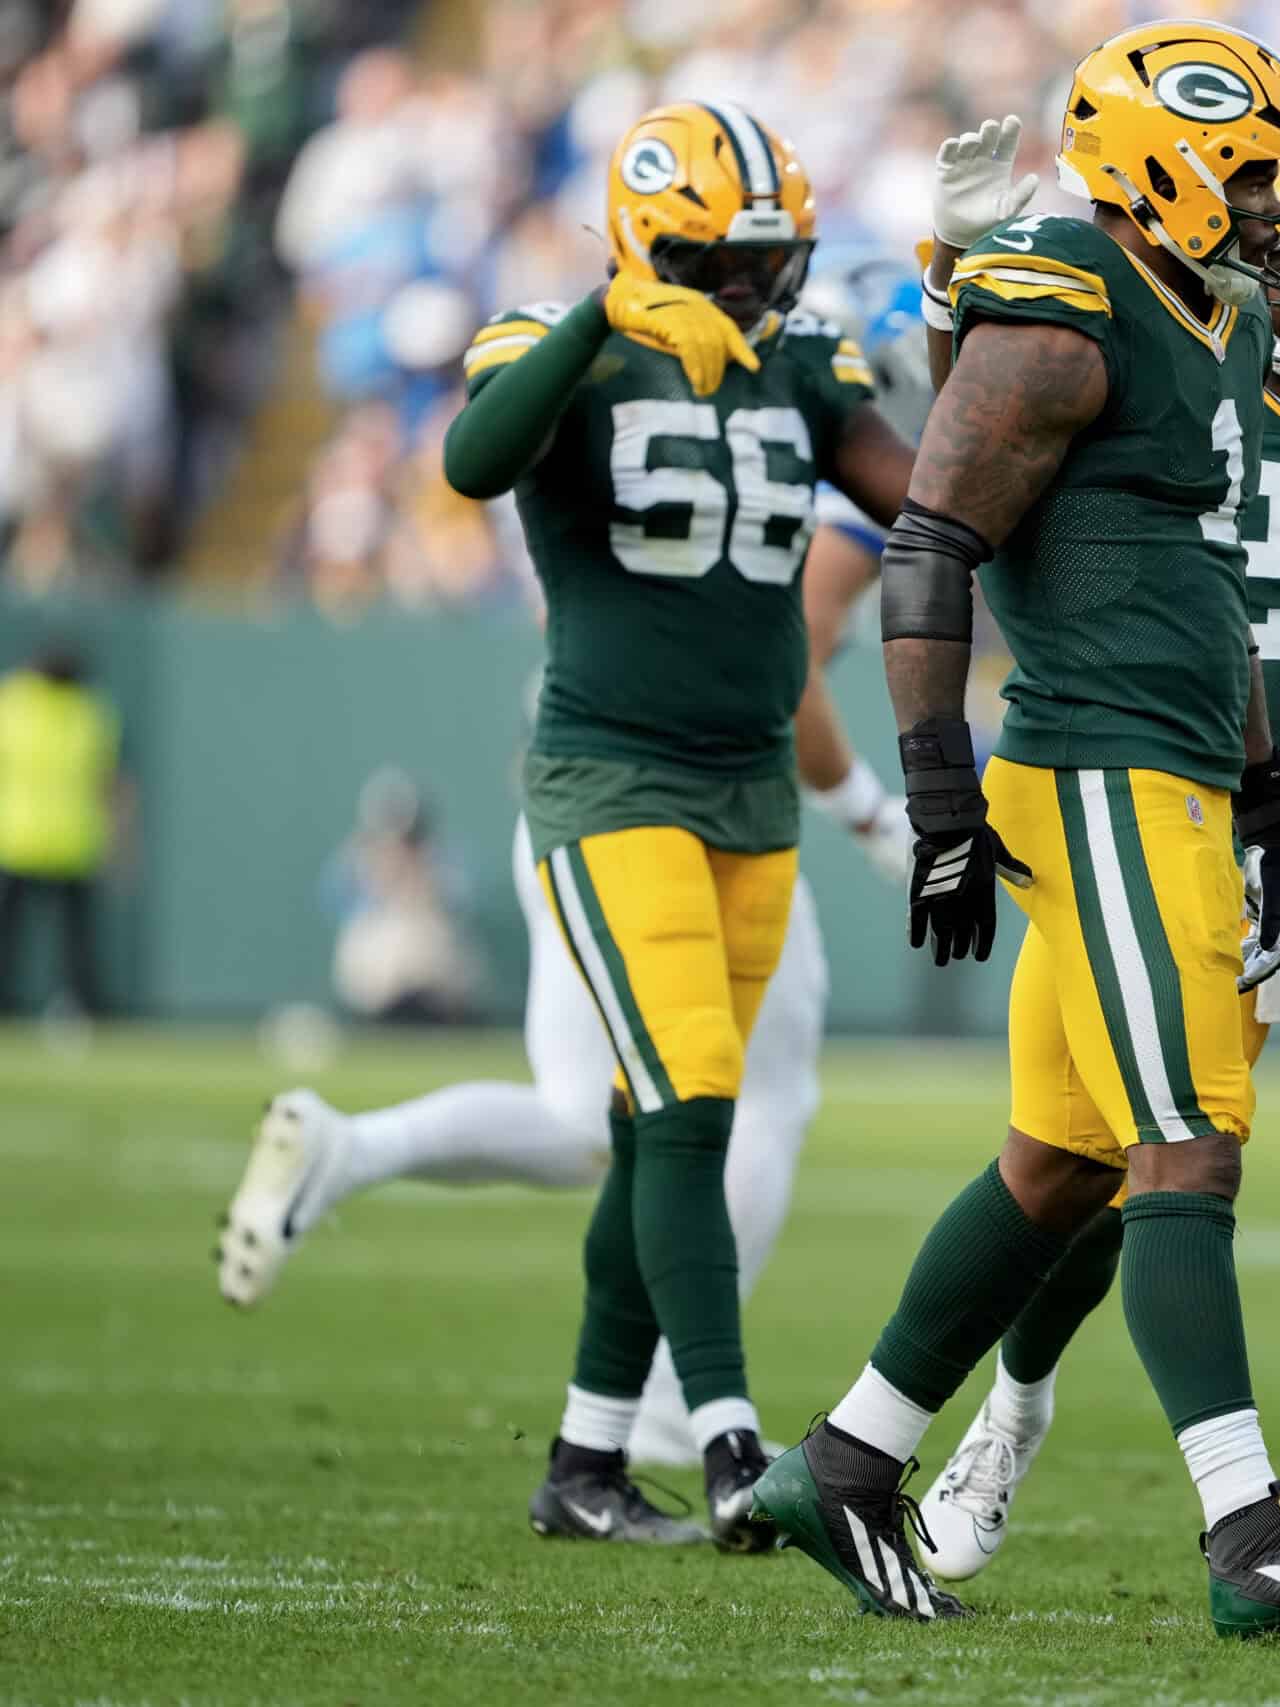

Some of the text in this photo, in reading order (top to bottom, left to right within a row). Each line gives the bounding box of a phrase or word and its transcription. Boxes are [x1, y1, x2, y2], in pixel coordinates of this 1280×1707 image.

[1156, 63, 1251, 121] G
[609, 400, 817, 585] 56
[1198, 398, 1243, 545] 1
